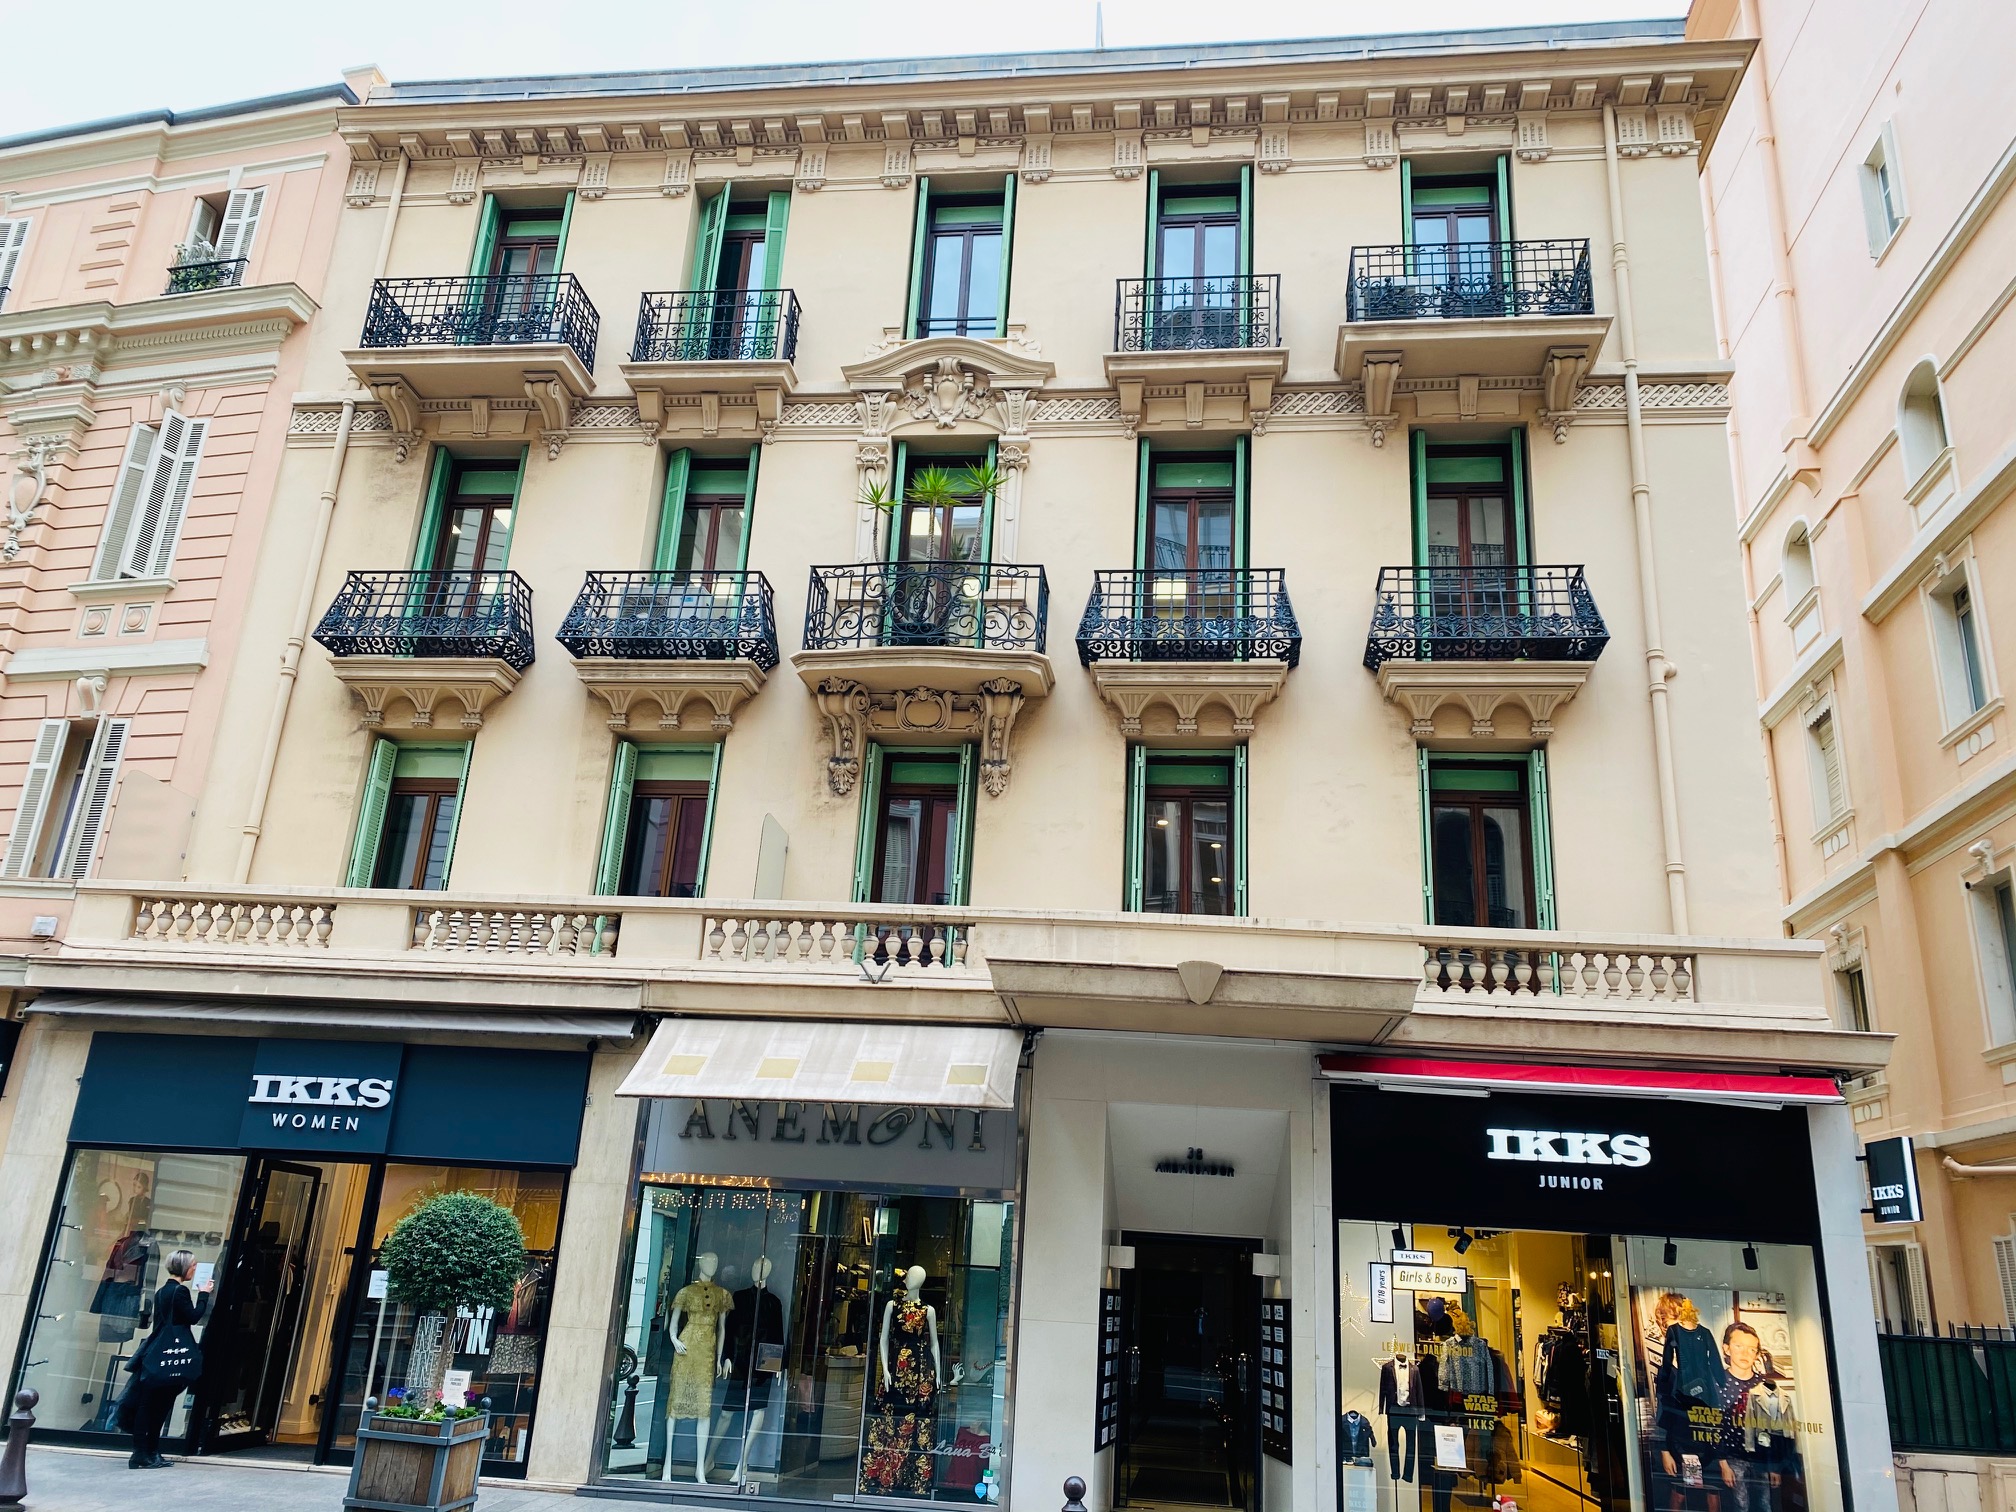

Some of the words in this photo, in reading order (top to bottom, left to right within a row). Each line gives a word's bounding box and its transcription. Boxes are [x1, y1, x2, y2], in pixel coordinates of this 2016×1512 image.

[248, 1074, 393, 1108] IKKS
[272, 1113, 359, 1131] WOMEN
[678, 1099, 986, 1150] ANEMONI
[1486, 1128, 1651, 1167] IKKS
[1539, 1175, 1604, 1190] JUNIOR
[1872, 1184, 1904, 1200] IKKS
[1378, 1270, 1386, 1289] years
[1400, 1270, 1423, 1283] Girls
[1426, 1272, 1432, 1283] &
[1434, 1273, 1458, 1287] Boys
[1382, 1341, 1391, 1351] LE
[160, 1358, 192, 1367] STORY
[1463, 1394, 1498, 1405] STAR
[1464, 1402, 1499, 1413] WARS
[1687, 1405, 1723, 1416] STAR
[1468, 1418, 1495, 1431] IKKS
[1688, 1413, 1723, 1424] WARS
[1692, 1430, 1721, 1443] IKKS
